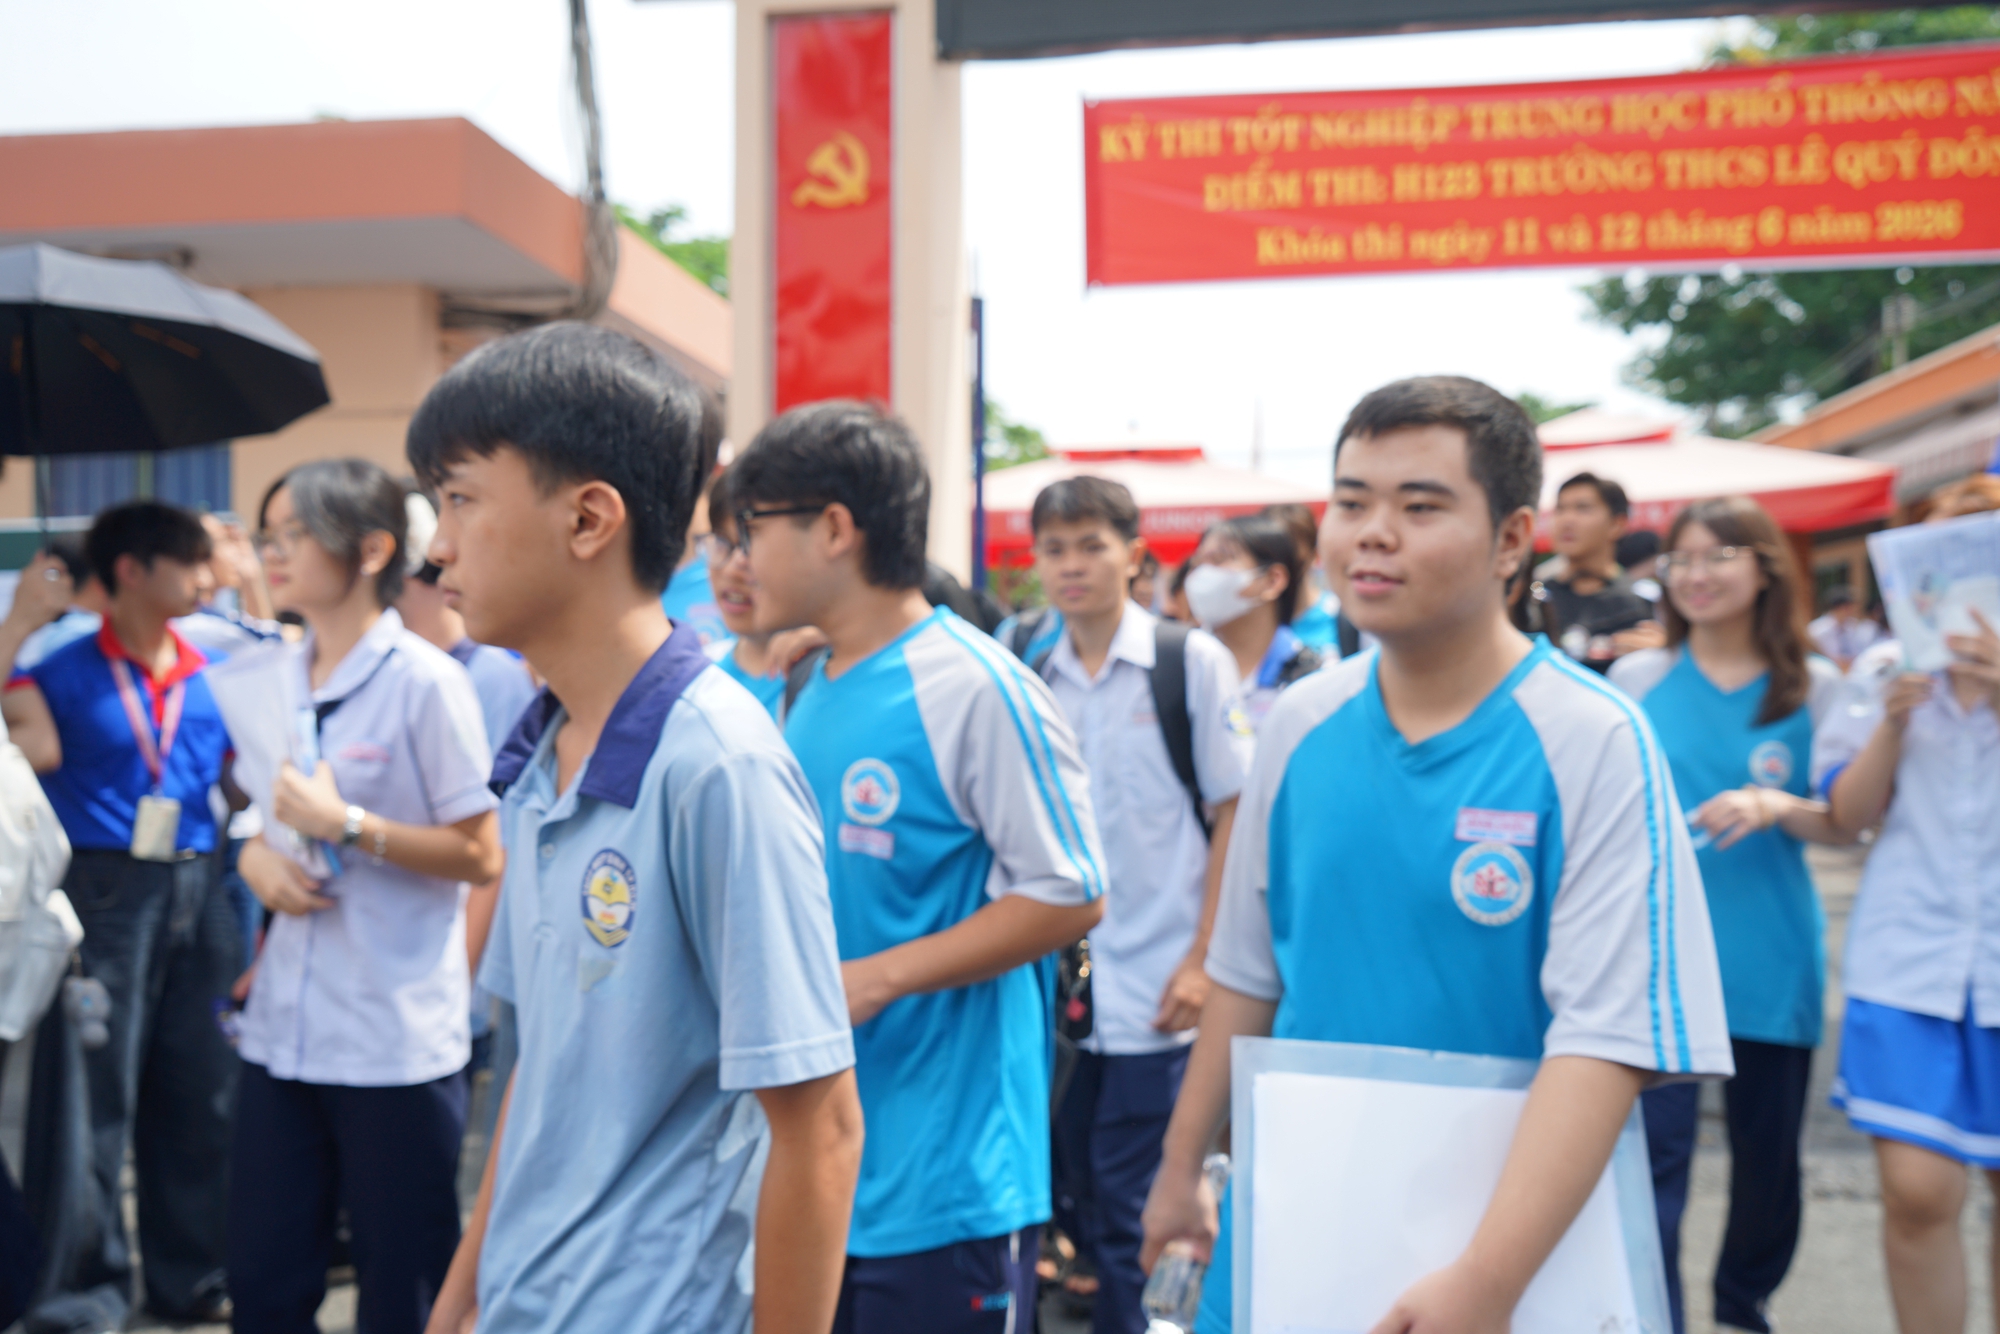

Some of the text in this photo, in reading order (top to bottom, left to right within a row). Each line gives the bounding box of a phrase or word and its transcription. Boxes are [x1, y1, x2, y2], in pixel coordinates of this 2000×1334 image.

[1156, 118, 1222, 158] THI
[1229, 101, 1304, 155] TỐT
[1310, 97, 1459, 151] NGHIỆP
[1466, 97, 1604, 143] TRUNG
[1610, 91, 1702, 140] HỌC
[1802, 71, 1949, 125] THÔNG
[1204, 156, 1302, 211] ĐIỂM
[1486, 143, 1656, 197] TRƯỜNG
[1658, 145, 1770, 191] THCS
[1773, 133, 1830, 186] LÊ
[1834, 129, 1923, 189] QUÝ
[1352, 222, 1403, 261] thi
[1408, 220, 1497, 263] ngày
[1503, 218, 1541, 255] 11
[1547, 213, 1594, 253] và
[1600, 211, 1643, 251] 12
[1645, 209, 1756, 254] tháng
[1757, 206, 1785, 246] 6
[1788, 205, 1873, 244] năm
